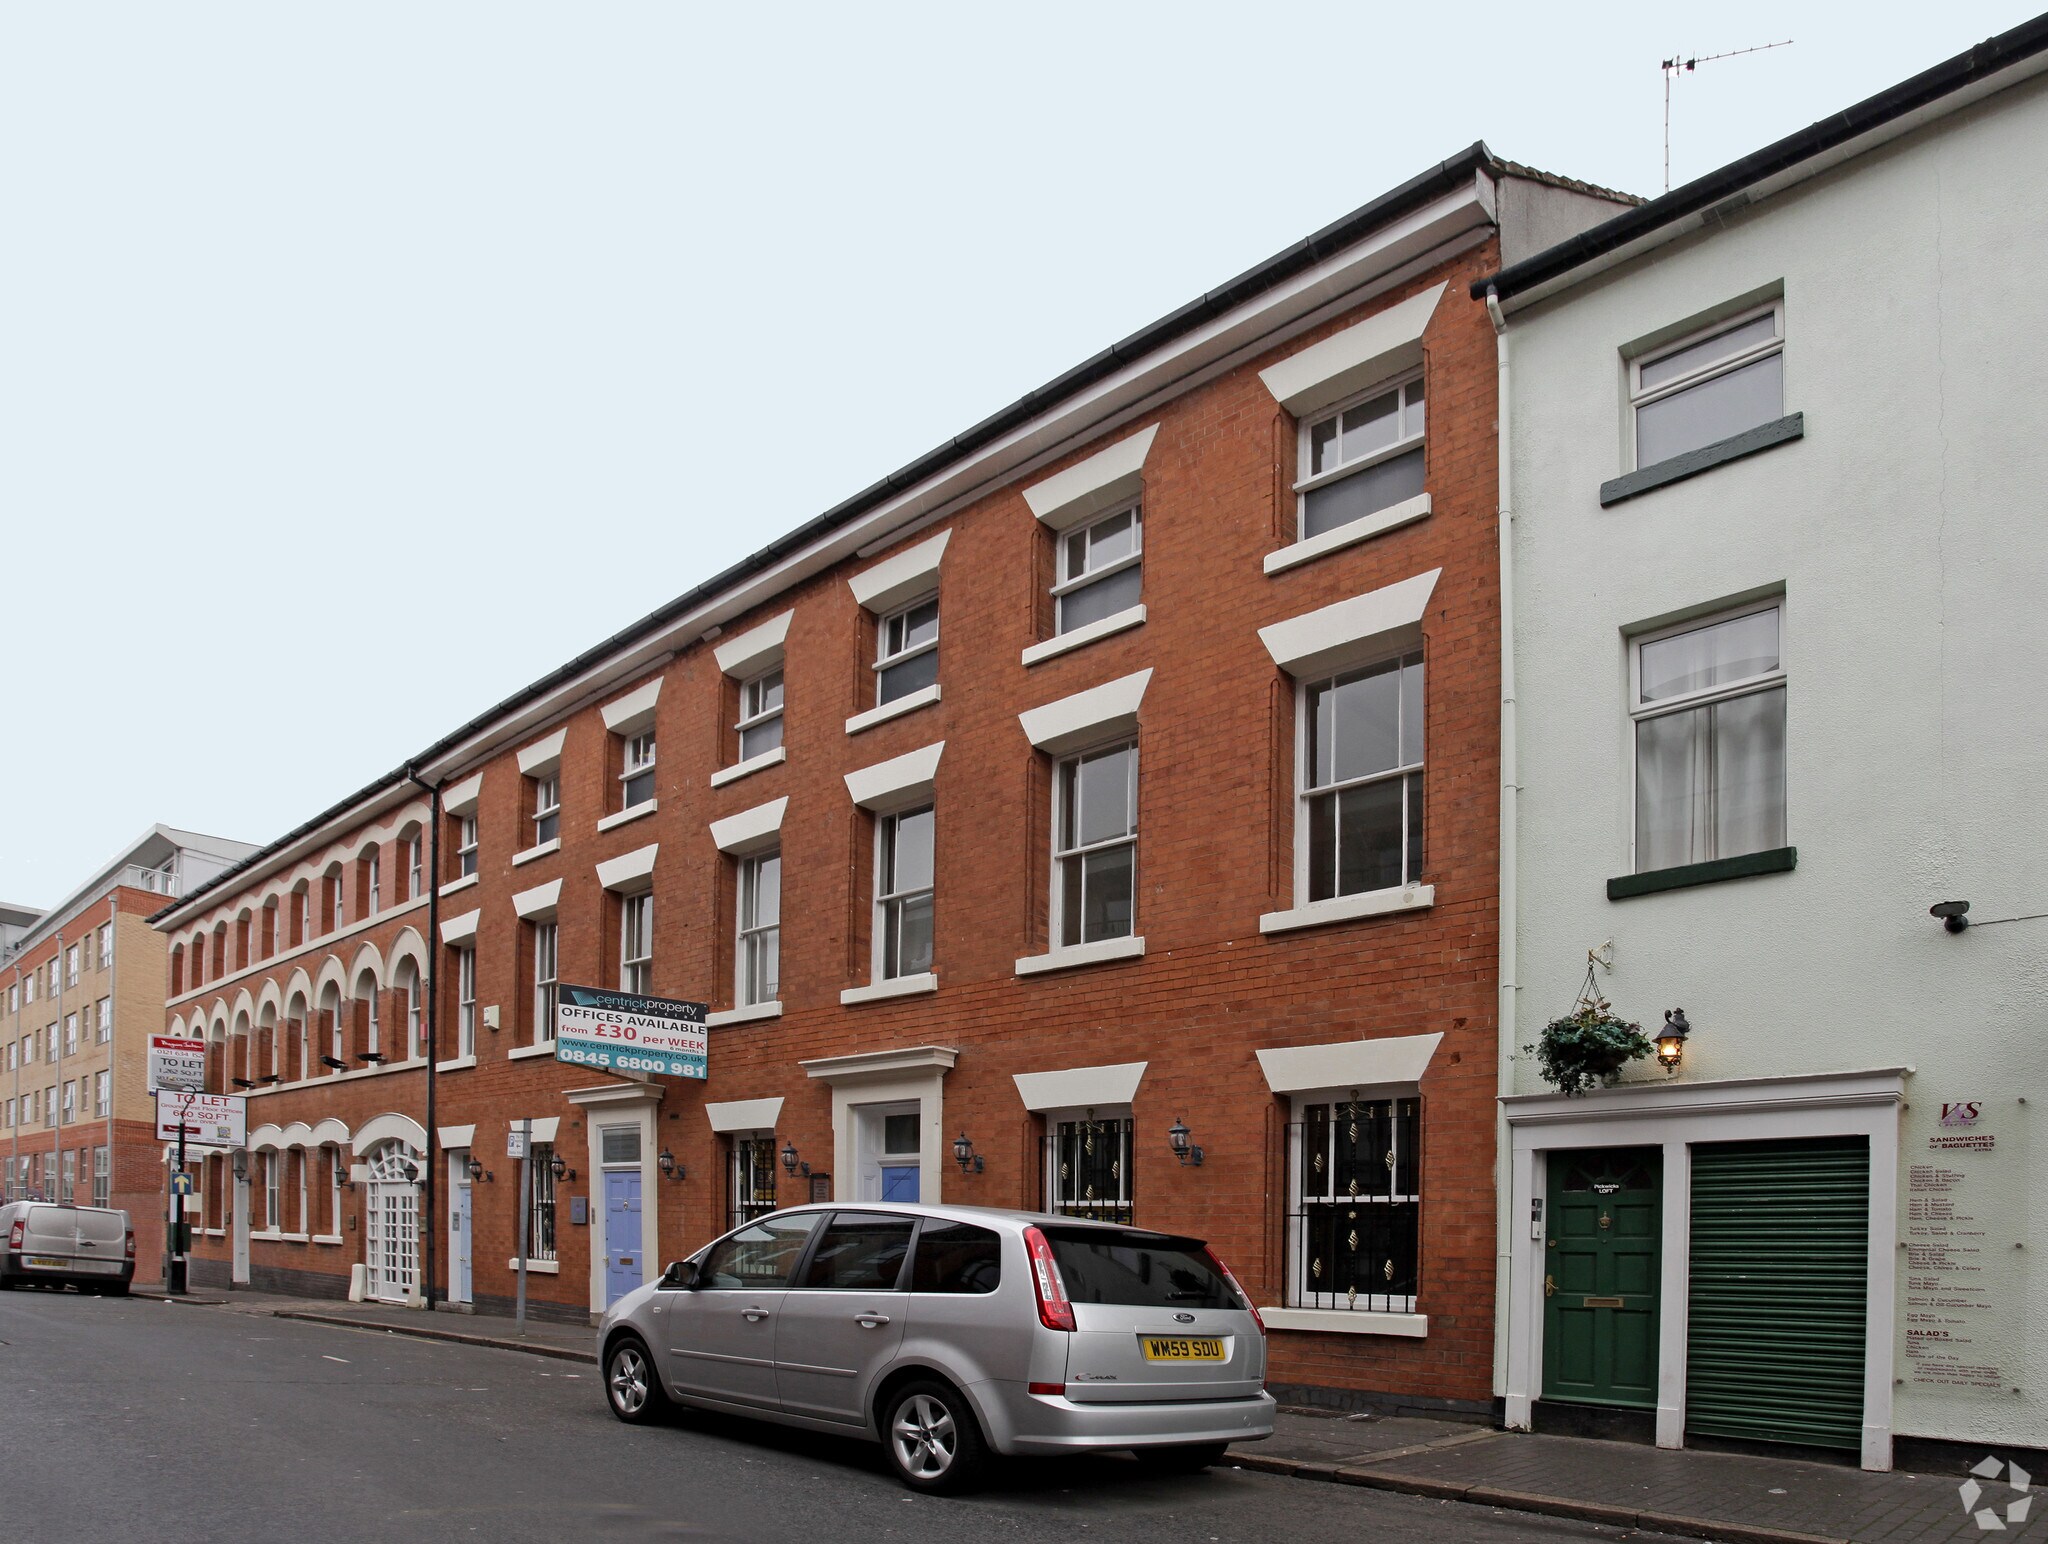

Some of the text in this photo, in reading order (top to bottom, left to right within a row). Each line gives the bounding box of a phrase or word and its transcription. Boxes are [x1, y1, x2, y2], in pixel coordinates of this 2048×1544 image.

[596, 995, 697, 1015] centrickproperty
[596, 1004, 697, 1020] commercial
[561, 1007, 705, 1034] OFFICES AVAILABLE
[561, 1023, 705, 1049] from £30 per WEEK
[562, 1040, 703, 1063] www.centrickproperty.co.uk
[161, 1058, 204, 1068] TO LET
[560, 1048, 704, 1077] 0845 6800 981
[175, 1094, 230, 1106] TO LET
[1151, 1341, 1220, 1356] WM59 SDU
